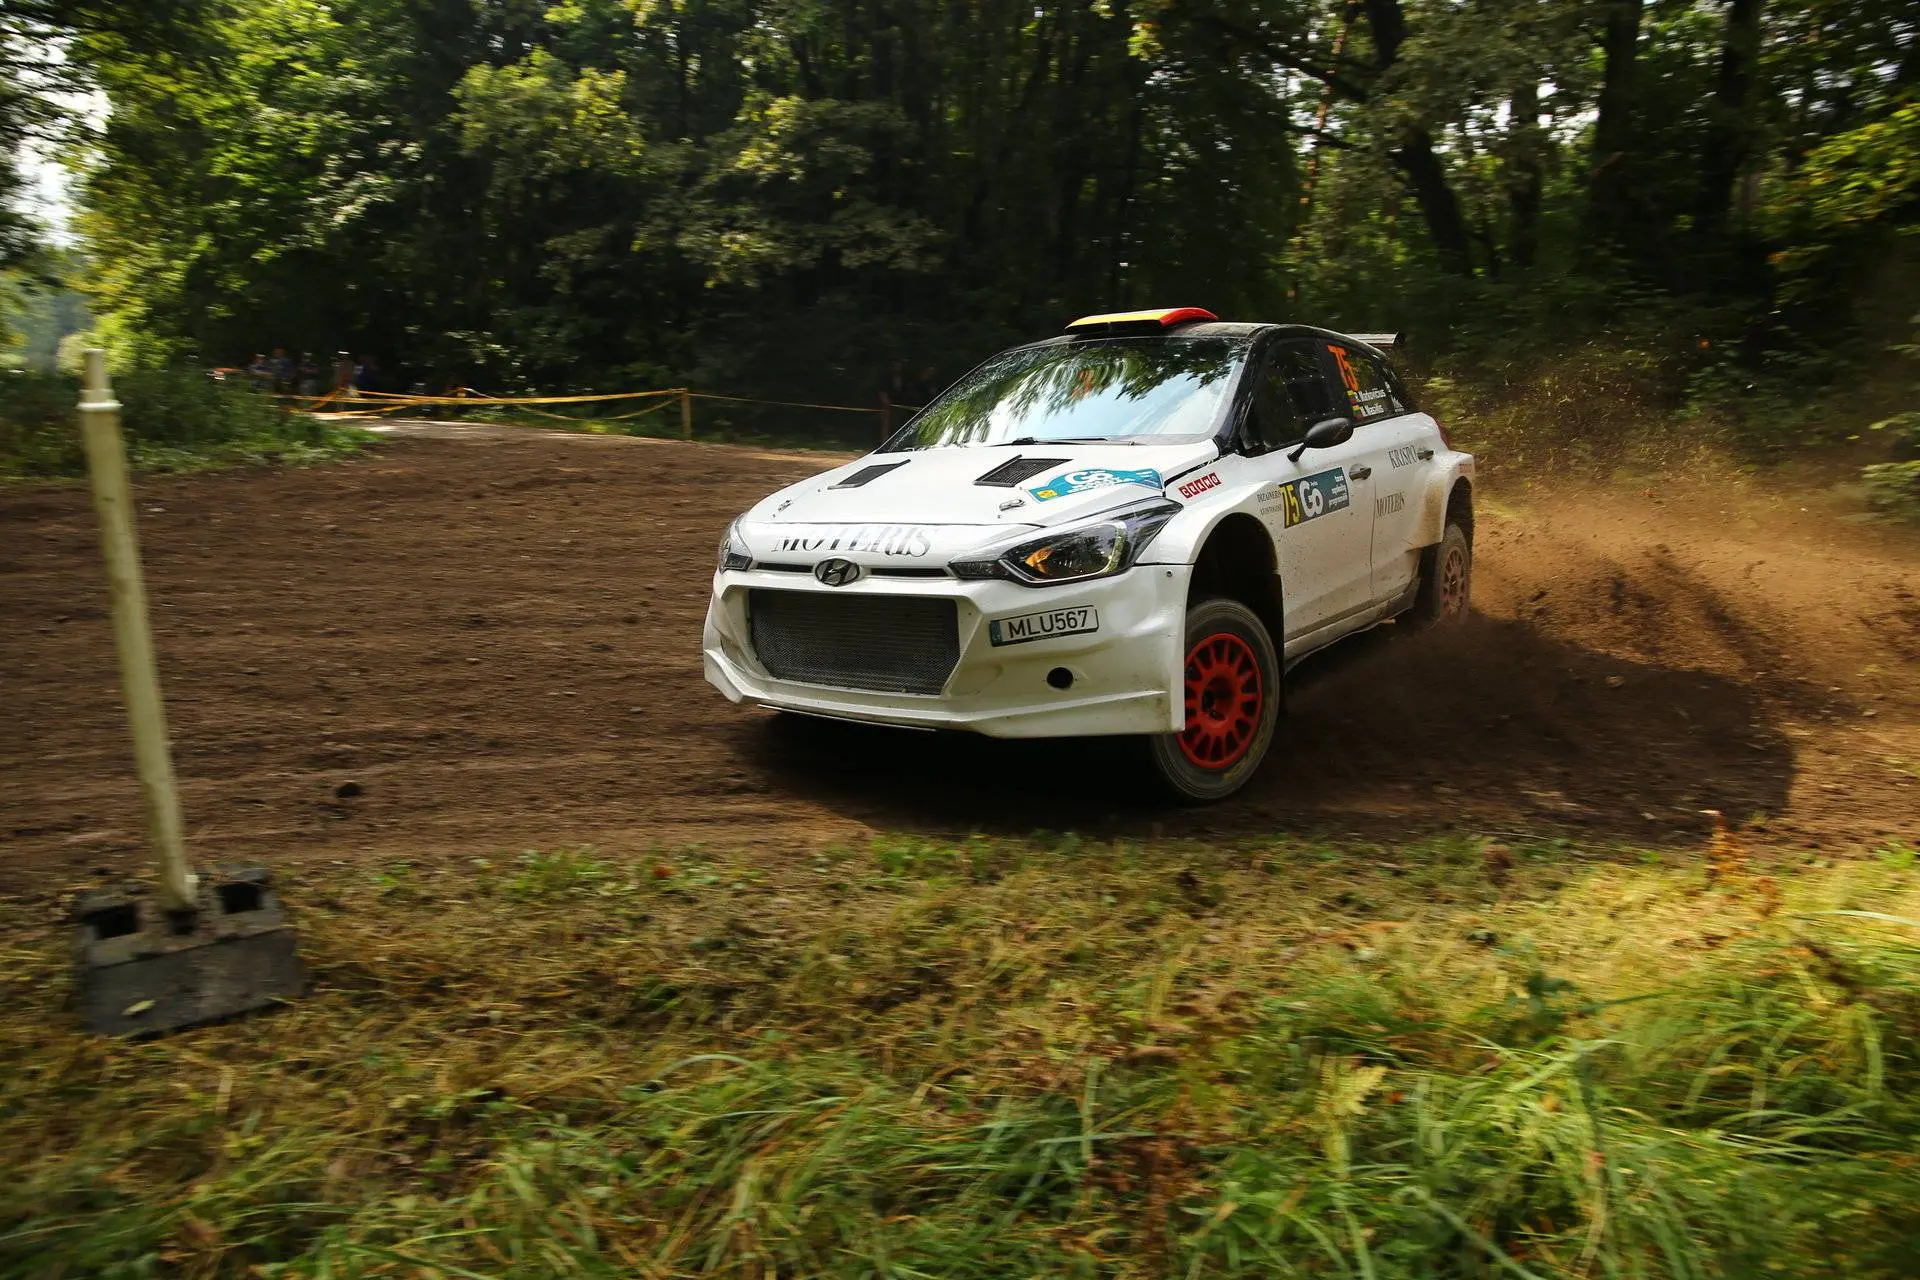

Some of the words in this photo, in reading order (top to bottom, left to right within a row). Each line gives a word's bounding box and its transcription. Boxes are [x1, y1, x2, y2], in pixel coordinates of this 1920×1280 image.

[1327, 344, 1359, 392] 75
[1179, 473, 1221, 498] CRAMO
[1299, 480, 1324, 517] Go
[1279, 484, 1300, 527] 75
[1007, 609, 1089, 639] MLU567
